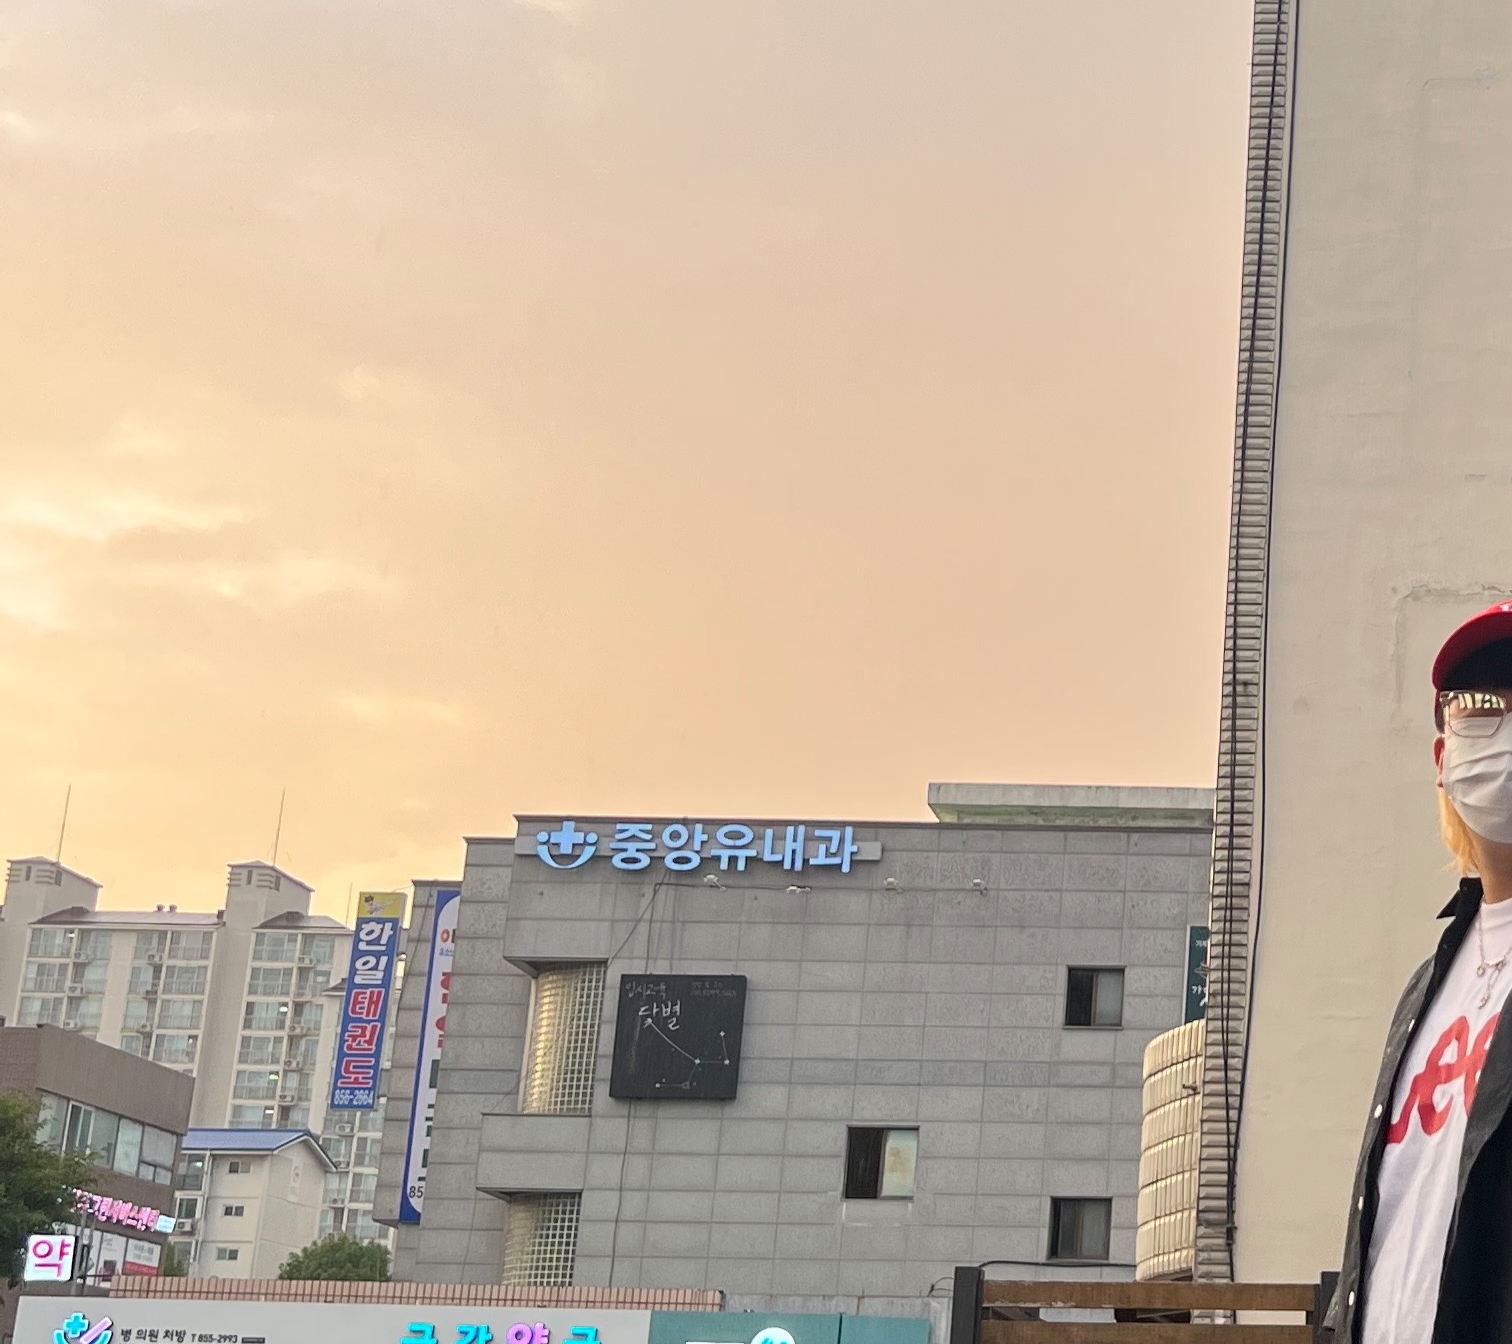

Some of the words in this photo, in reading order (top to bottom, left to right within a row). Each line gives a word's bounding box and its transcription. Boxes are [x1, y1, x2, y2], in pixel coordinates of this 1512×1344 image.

[608, 823, 859, 874] 중앙유내과
[337, 921, 393, 1088] 한일태권도
[32, 1238, 71, 1278] 약
[163, 1328, 186, 1344] 처방
